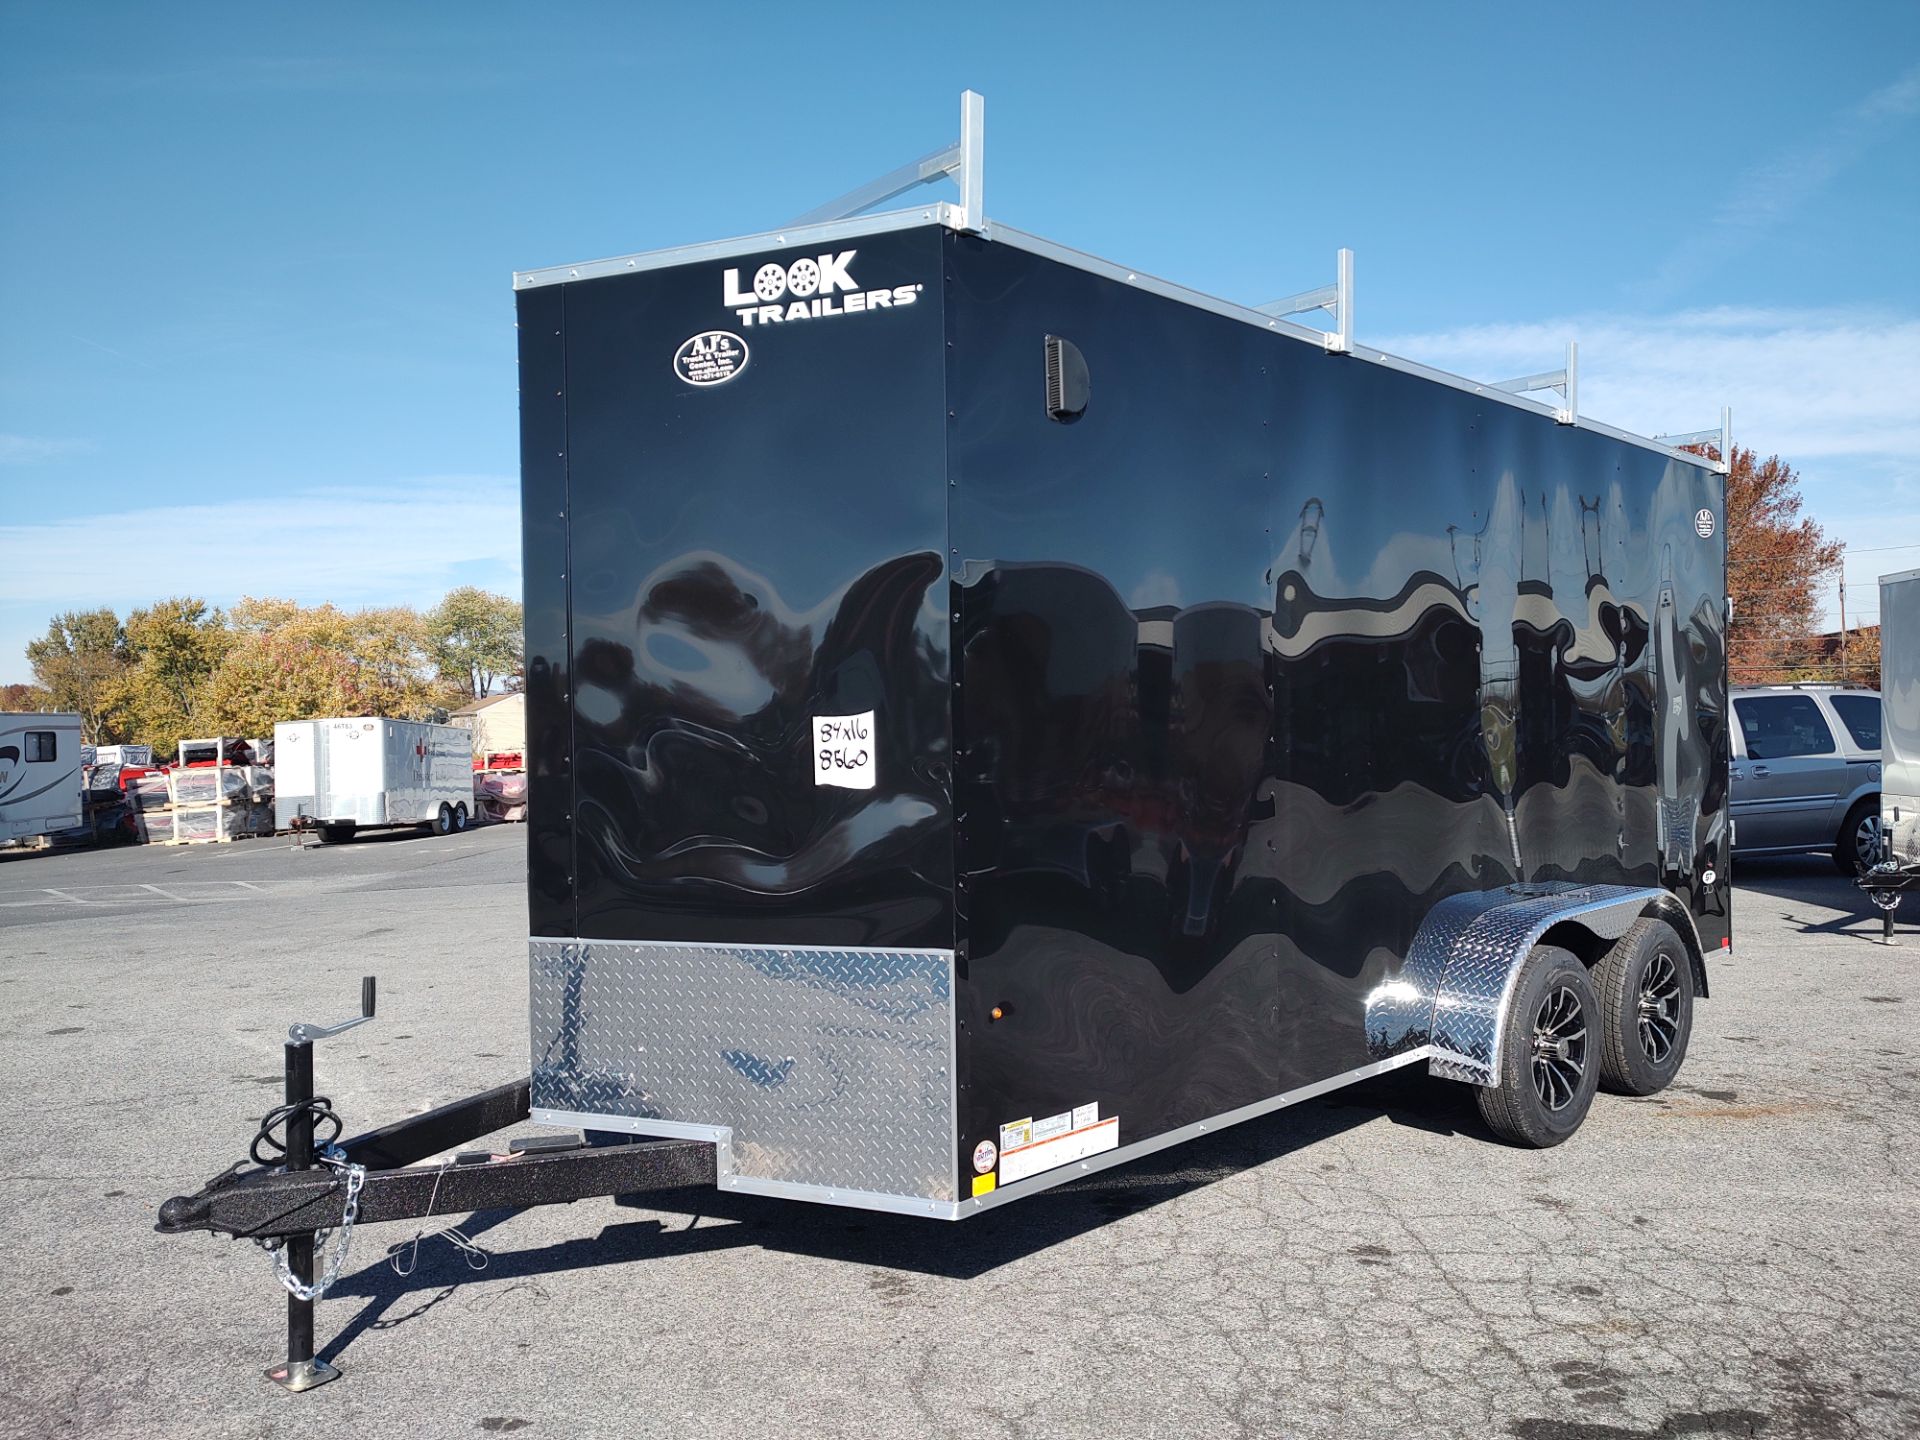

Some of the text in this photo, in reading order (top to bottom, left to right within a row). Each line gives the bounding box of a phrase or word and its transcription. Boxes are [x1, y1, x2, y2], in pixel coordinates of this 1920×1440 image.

[723, 250, 859, 307] LOOK
[736, 284, 918, 327] TRAILERS
[681, 355, 704, 364] Truck
[713, 349, 739, 359] Trailer
[691, 335, 730, 356] AJ's
[819, 747, 868, 771] 8560
